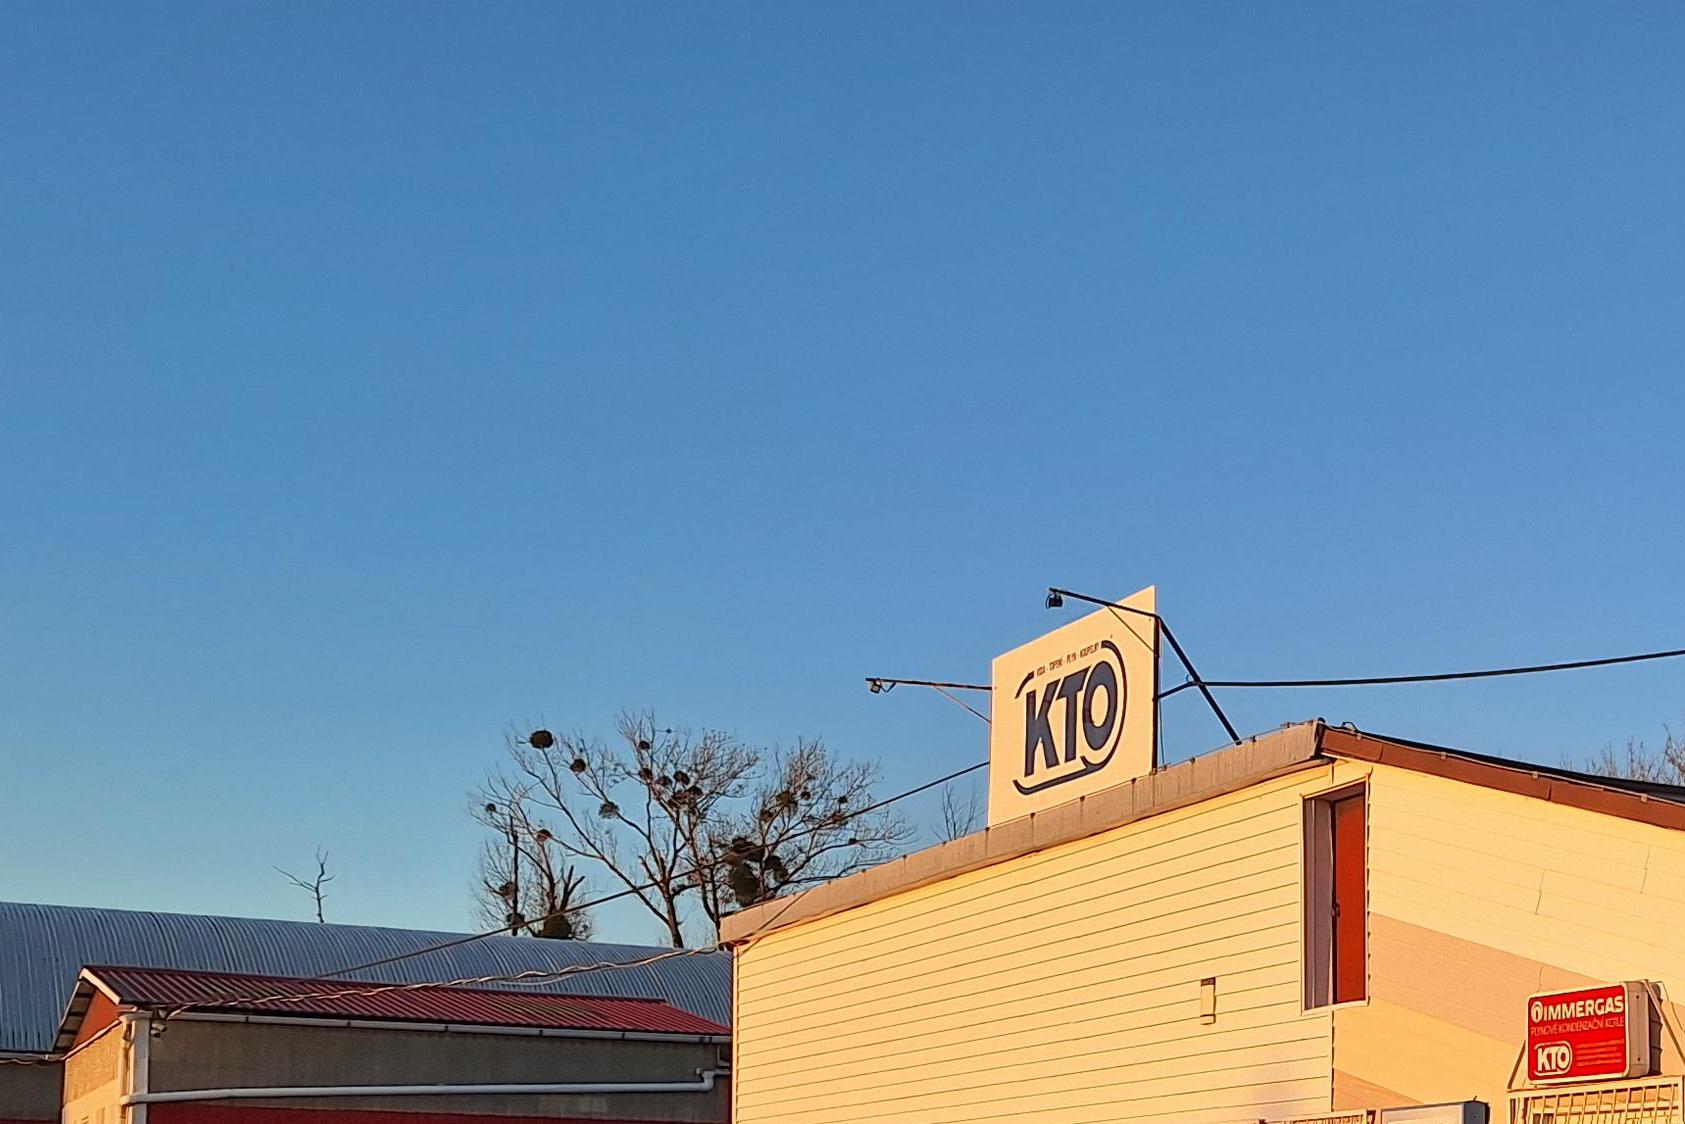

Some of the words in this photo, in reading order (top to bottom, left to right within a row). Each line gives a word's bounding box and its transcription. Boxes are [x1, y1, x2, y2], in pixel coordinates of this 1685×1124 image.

[1024, 660, 1118, 778] KTO
[1543, 995, 1624, 1021] IMMERGAS
[1537, 1046, 1570, 1072] KTO
